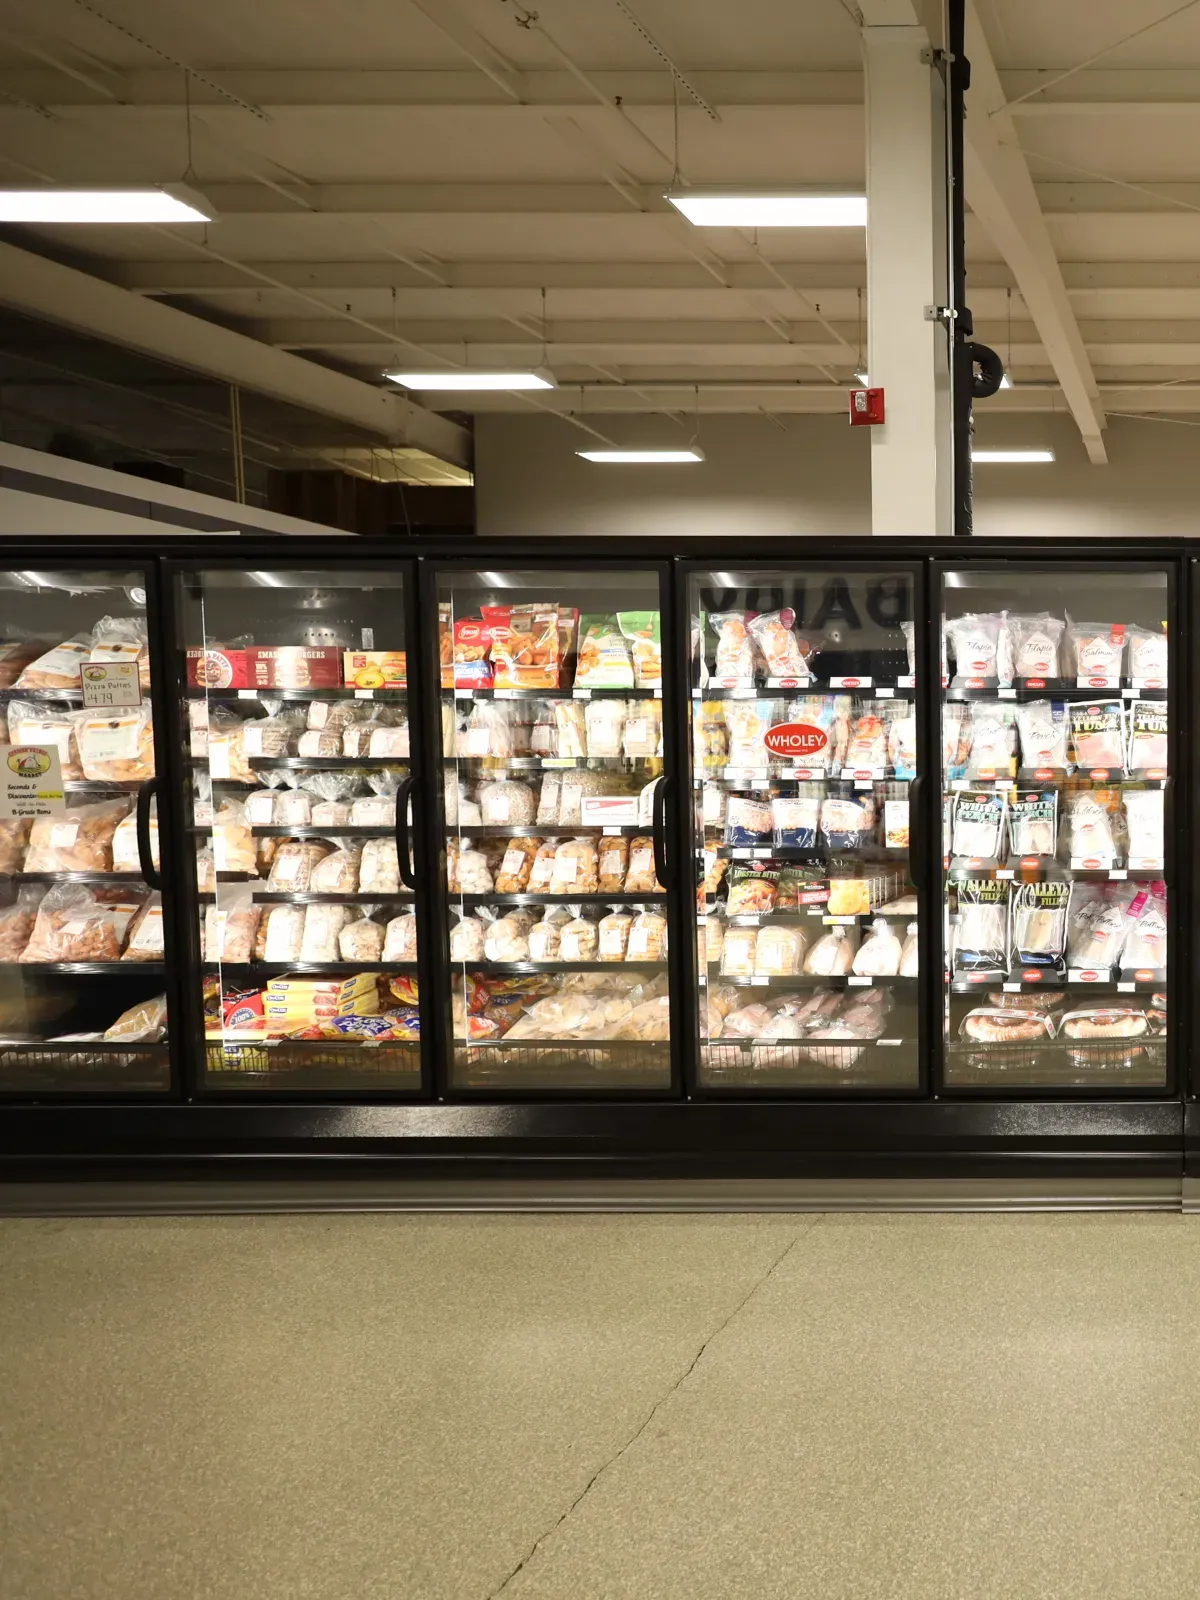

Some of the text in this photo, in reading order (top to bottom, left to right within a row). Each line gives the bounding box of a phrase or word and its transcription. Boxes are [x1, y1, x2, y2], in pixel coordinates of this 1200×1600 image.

[967, 641, 992, 652] Tilapia
[1026, 643, 1053, 653] Tilapia
[1085, 648, 1113, 657] Salmon
[107, 682, 132, 690] Patties
[1029, 730, 1057, 740] Perch
[767, 735, 824, 747] WHOLEY
[961, 801, 1000, 812] WHITE
[1012, 801, 1054, 811] WHITE
[957, 810, 999, 821] PERCH
[1013, 809, 1053, 819] PERCH
